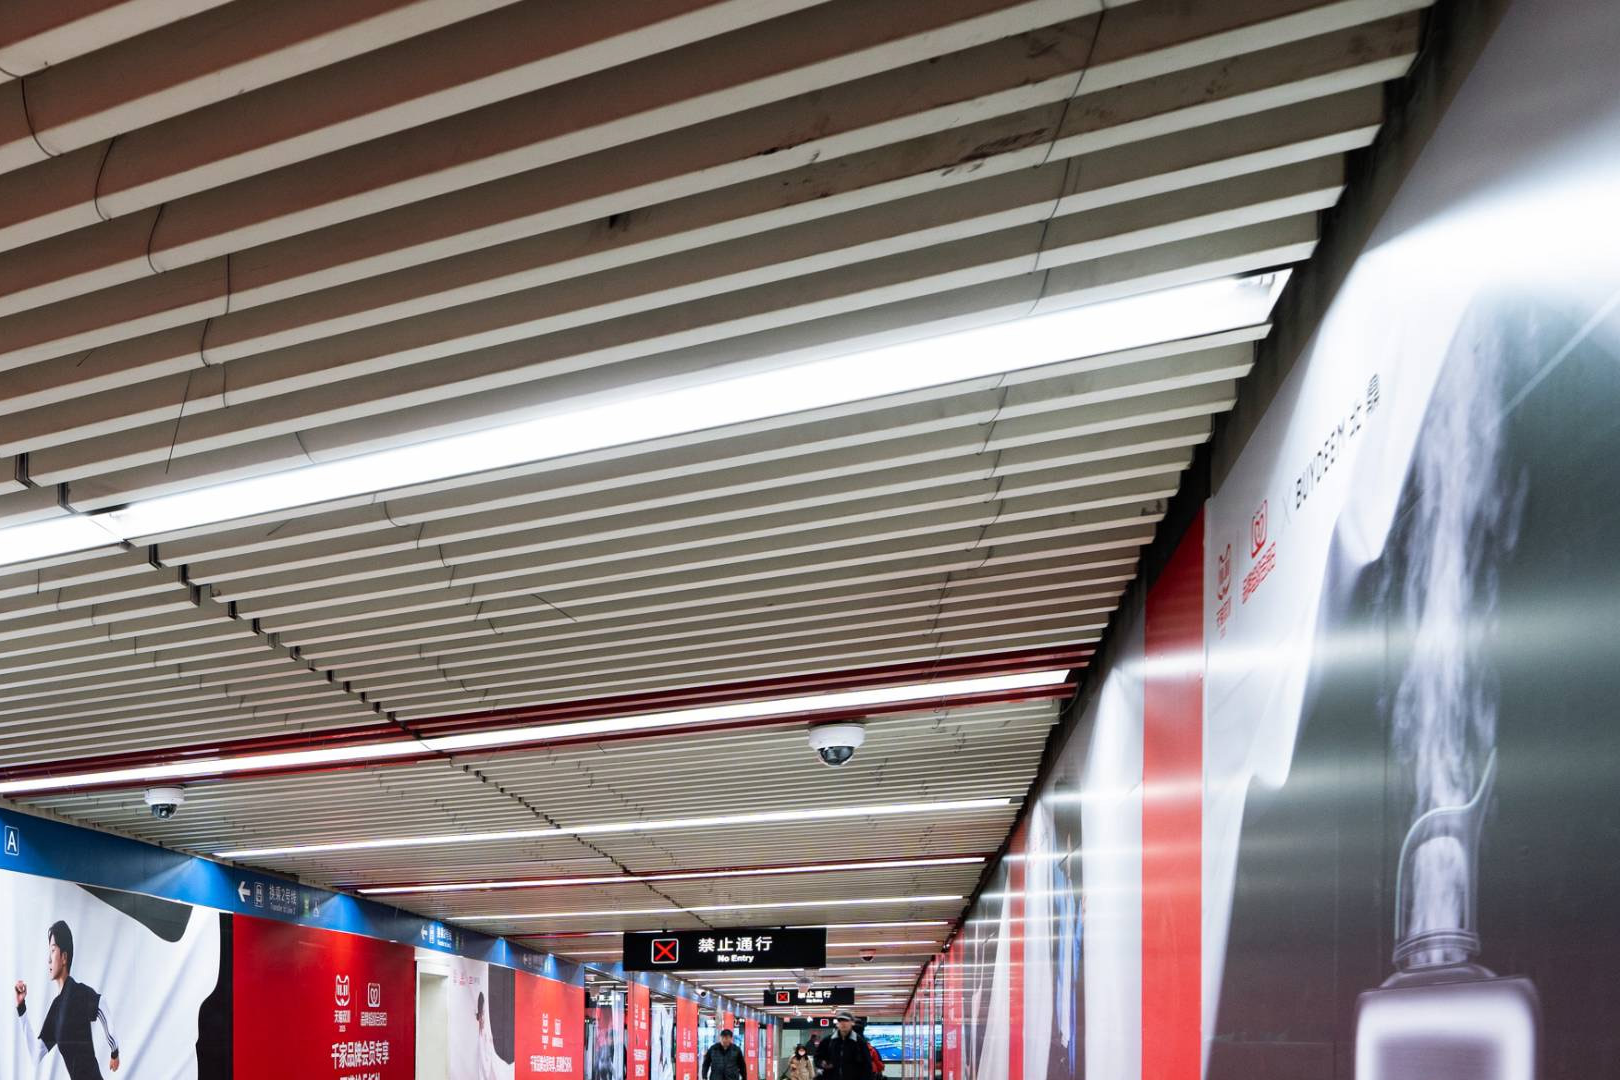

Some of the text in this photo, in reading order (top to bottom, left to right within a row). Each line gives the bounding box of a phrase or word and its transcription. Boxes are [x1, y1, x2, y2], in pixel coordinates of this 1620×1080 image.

[7, 829, 17, 853] A
[698, 936, 773, 953] 禁止通行
[717, 954, 754, 963] No Entry
[331, 1040, 390, 1070] 千家品牌会员专享
